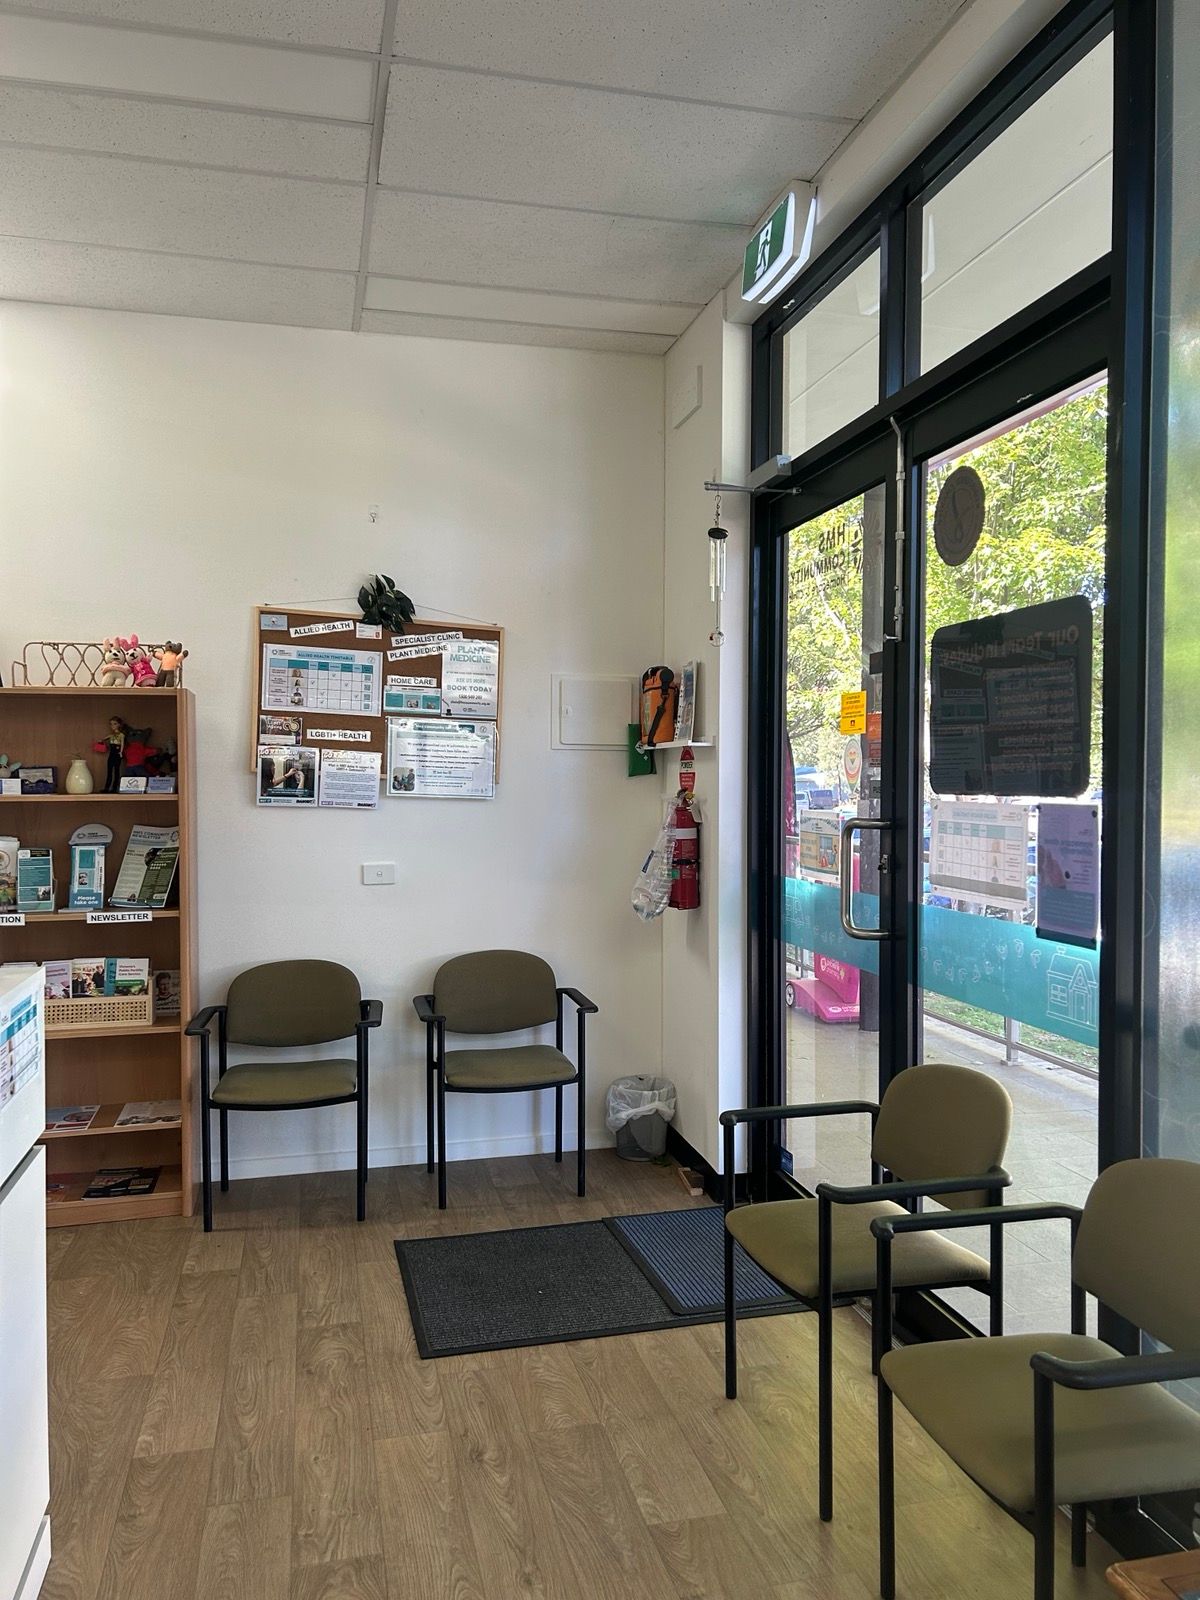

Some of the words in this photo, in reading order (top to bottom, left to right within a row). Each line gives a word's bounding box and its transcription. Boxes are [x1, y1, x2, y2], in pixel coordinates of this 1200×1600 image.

[294, 626, 320, 635] ALLIED
[321, 622, 350, 632] HEALTH
[395, 635, 436, 645] SPECIALIST
[437, 632, 461, 642] CLINIC
[390, 650, 413, 659] PLANT
[414, 644, 448, 655] MEDICINE
[457, 645, 486, 655] PLANT
[449, 654, 492, 664] MEDICINE
[91, 913, 149, 922] NEWSLETTER
